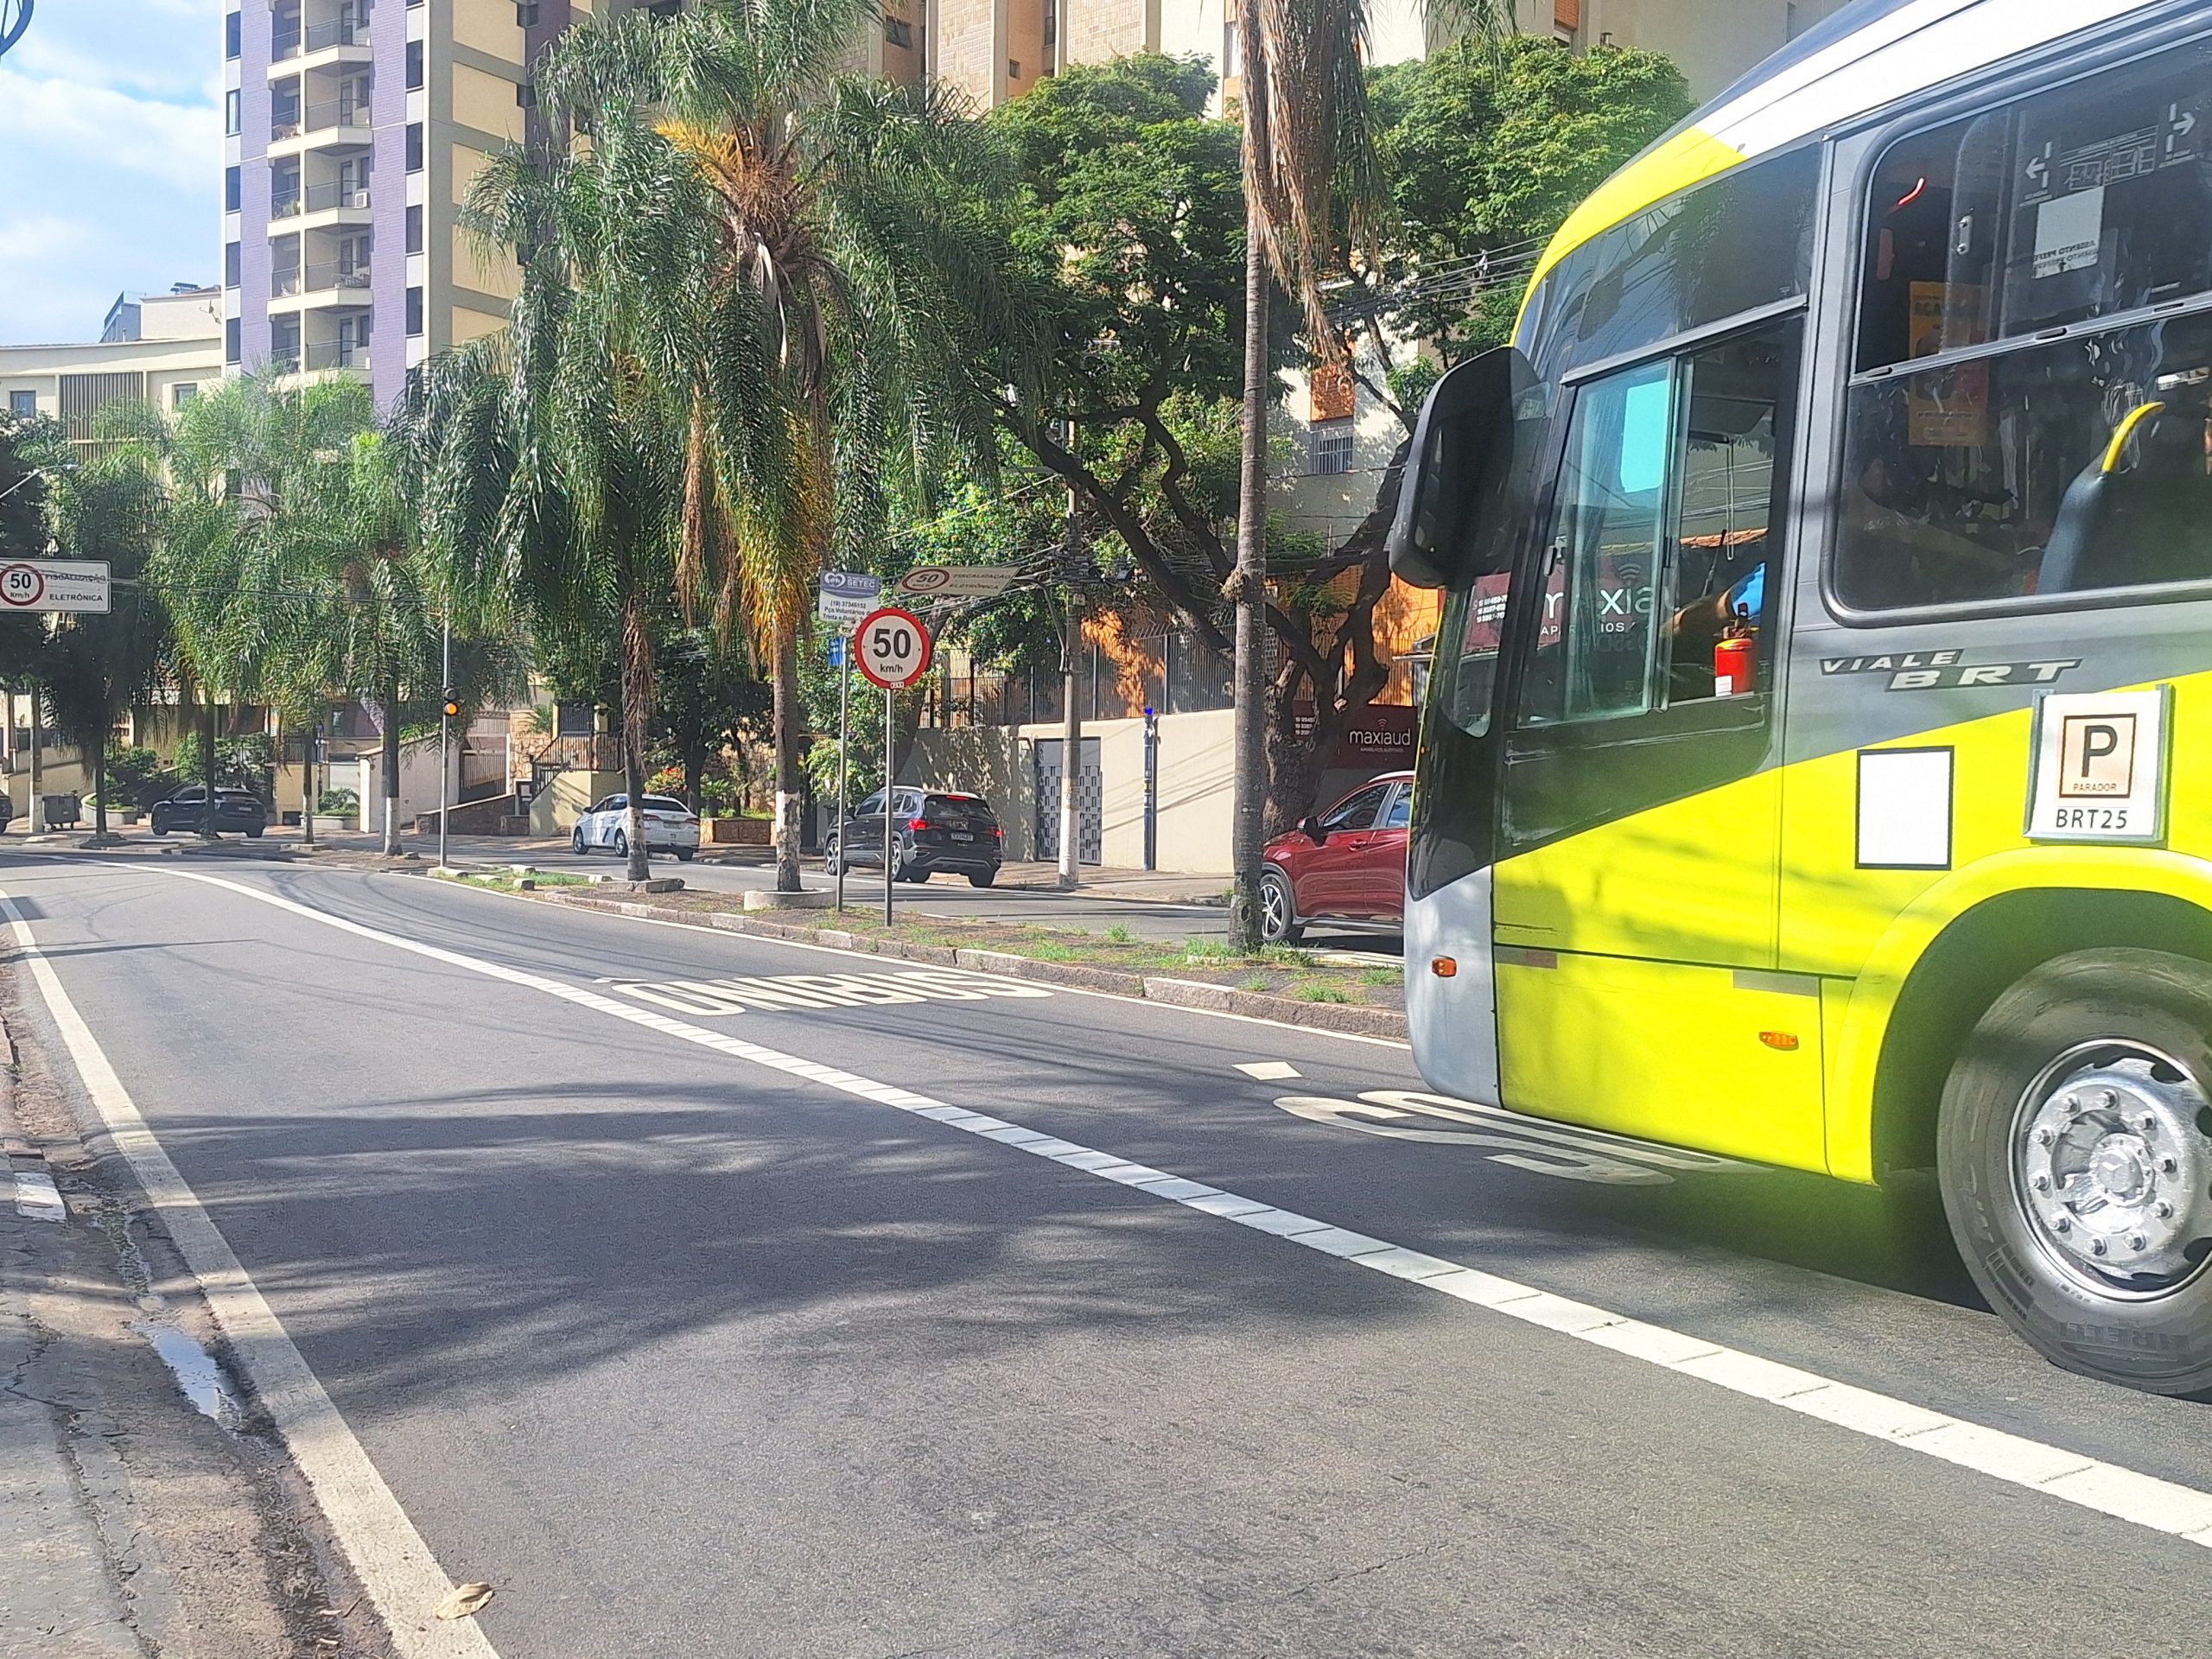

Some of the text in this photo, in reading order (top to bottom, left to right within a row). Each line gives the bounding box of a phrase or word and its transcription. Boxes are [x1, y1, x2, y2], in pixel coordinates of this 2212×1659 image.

[10, 573, 31, 589] 50
[916, 574, 939, 583] 50
[49, 593, 103, 601] ELETRÔNICA
[873, 628, 912, 658] 50
[880, 664, 903, 673] km/h
[1822, 651, 1958, 673] VIALE
[1889, 660, 2079, 690] BRT
[1349, 728, 1411, 746] maxiaud
[2081, 724, 2118, 778] P
[2073, 782, 2117, 792] PARADOR
[2056, 809, 2128, 830] BRT25
